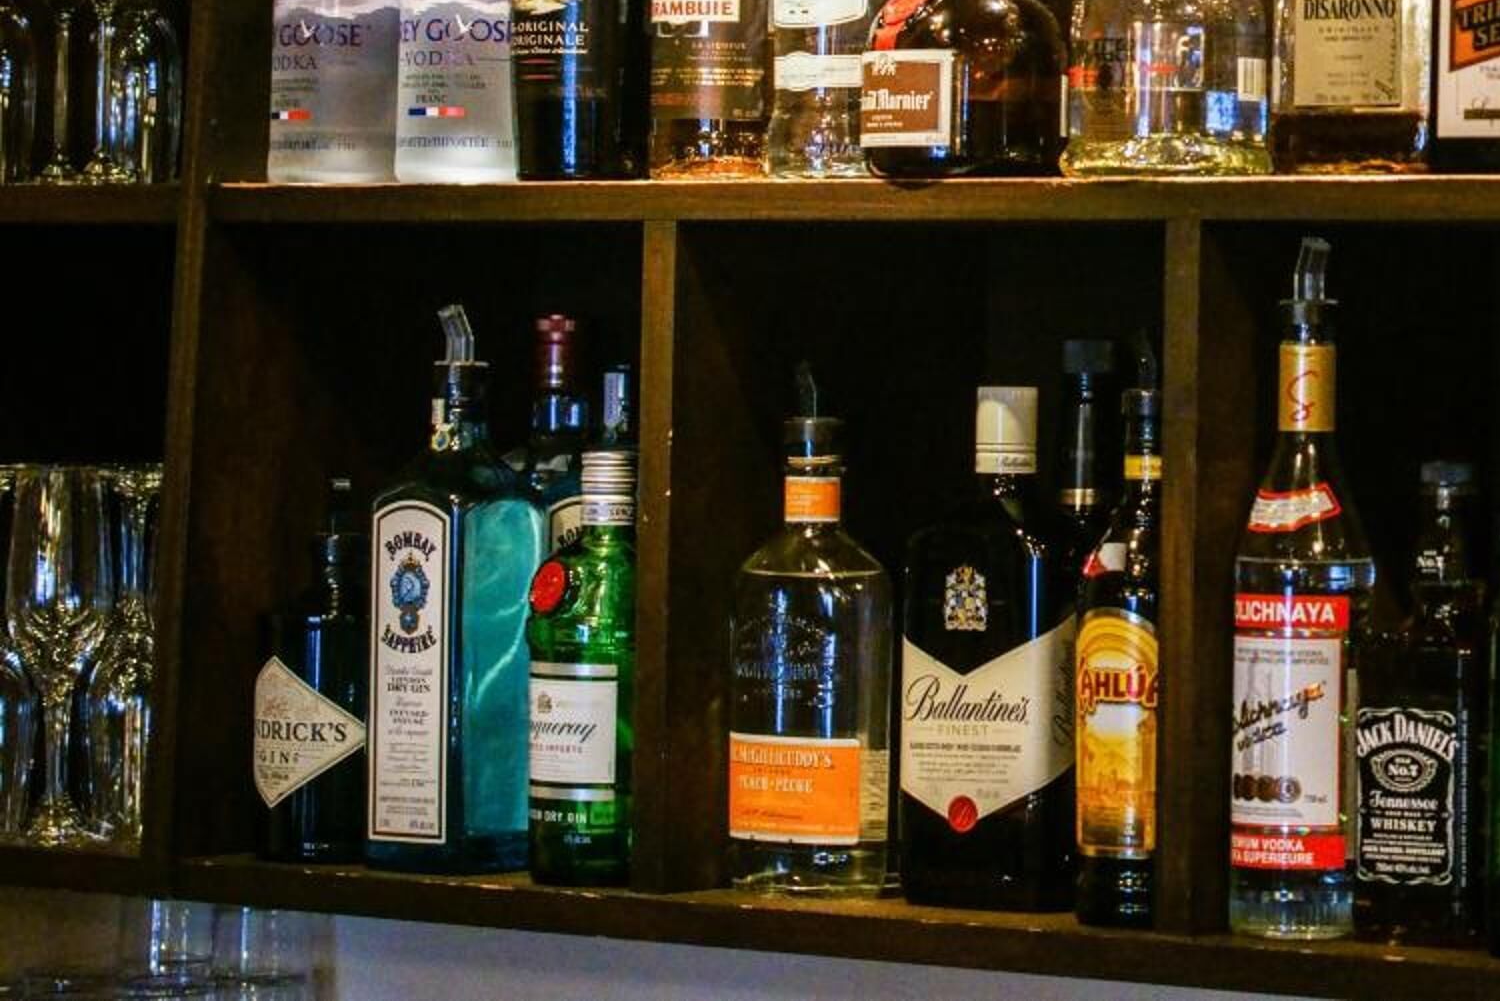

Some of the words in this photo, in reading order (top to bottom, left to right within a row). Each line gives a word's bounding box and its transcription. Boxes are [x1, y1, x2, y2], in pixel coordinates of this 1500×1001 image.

[279, 23, 362, 47] GOOSE
[273, 54, 317, 70] ODKA
[385, 531, 437, 561] BOMBAY
[381, 624, 437, 654] SAPPHIRE
[386, 683, 408, 693] DRY
[411, 683, 431, 693] GIN
[904, 674, 1030, 724] Ballantine's
[937, 725, 989, 737] FINEST
[1357, 721, 1392, 757] JACK
[1394, 713, 1460, 761] DANIEL'S
[259, 750, 289, 764] GIN
[1369, 790, 1438, 810] Tennessee
[1371, 817, 1436, 833] WHISKEY
